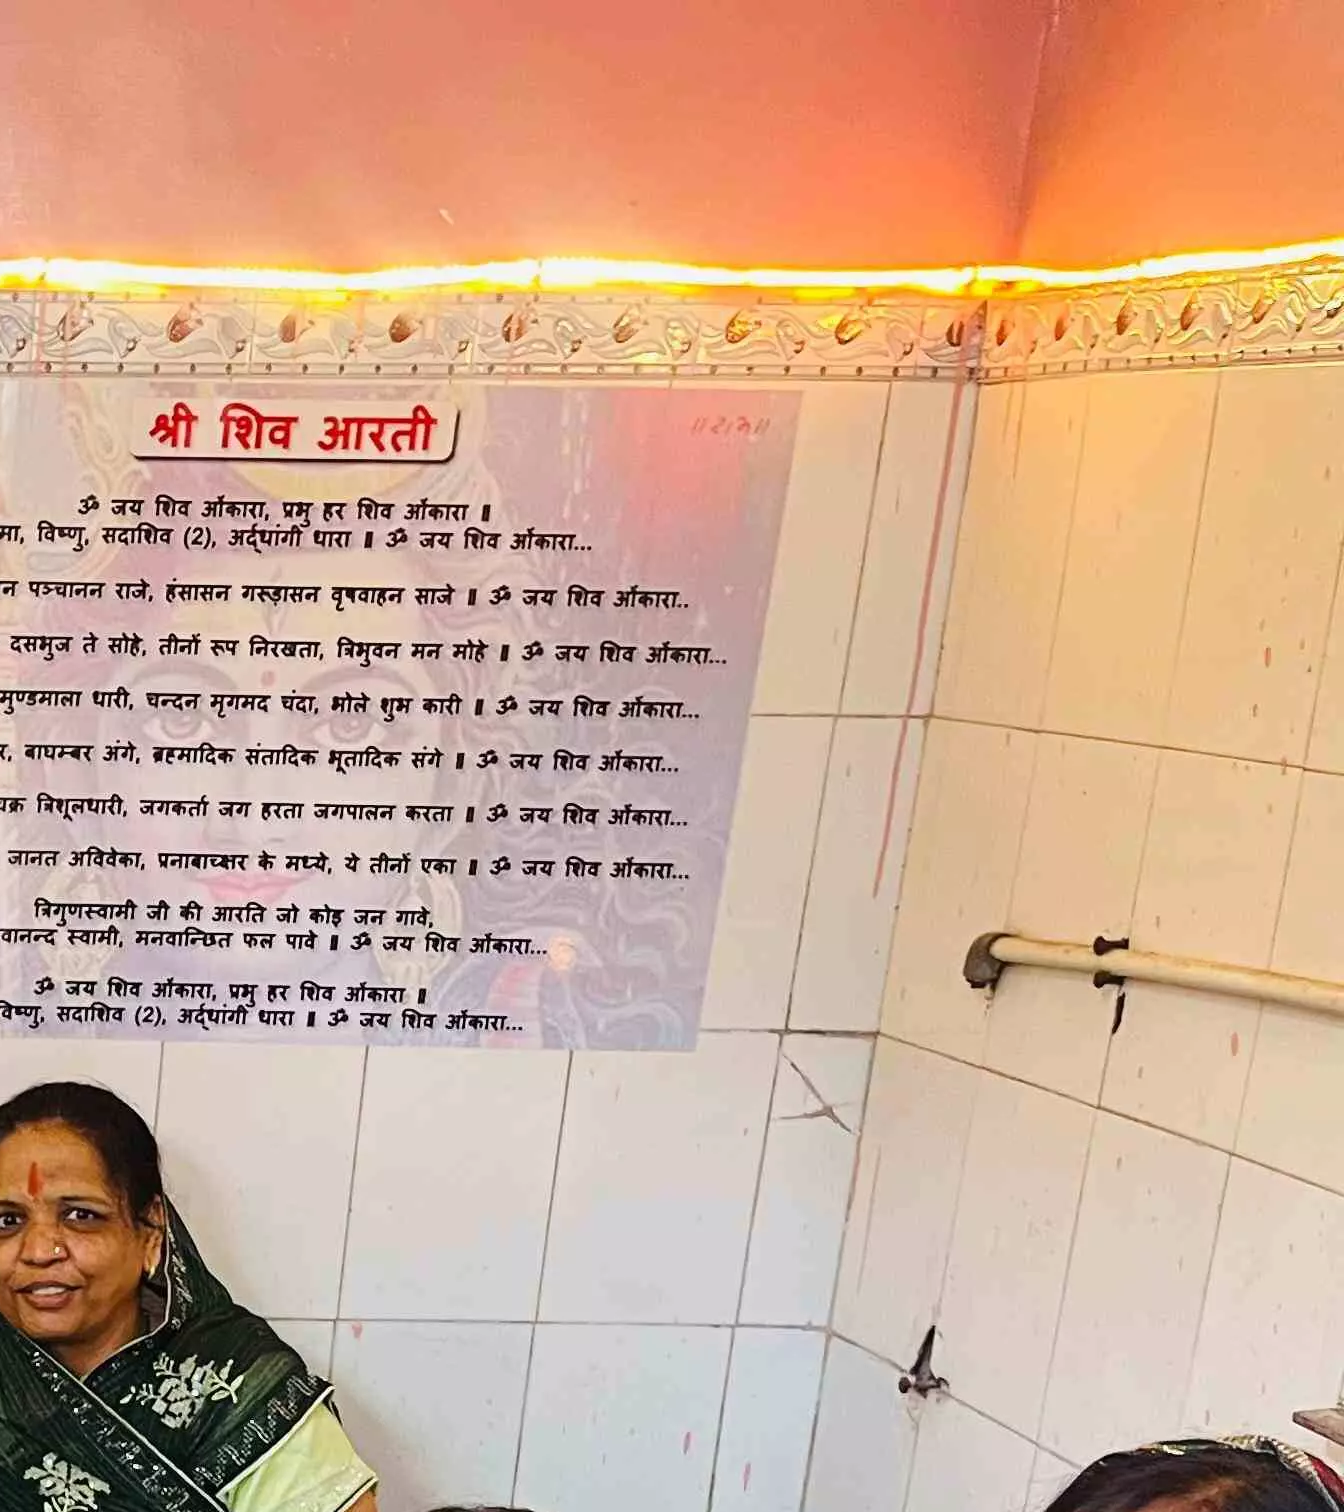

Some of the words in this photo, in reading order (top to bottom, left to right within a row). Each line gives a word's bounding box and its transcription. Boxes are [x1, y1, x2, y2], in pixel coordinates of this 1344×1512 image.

[149, 402, 198, 448] श्री
[220, 403, 299, 449] शिव
[318, 407, 438, 453] आरती
[155, 495, 192, 517] शिव
[357, 497, 395, 520] शिव
[600, 641, 637, 662] शिव
